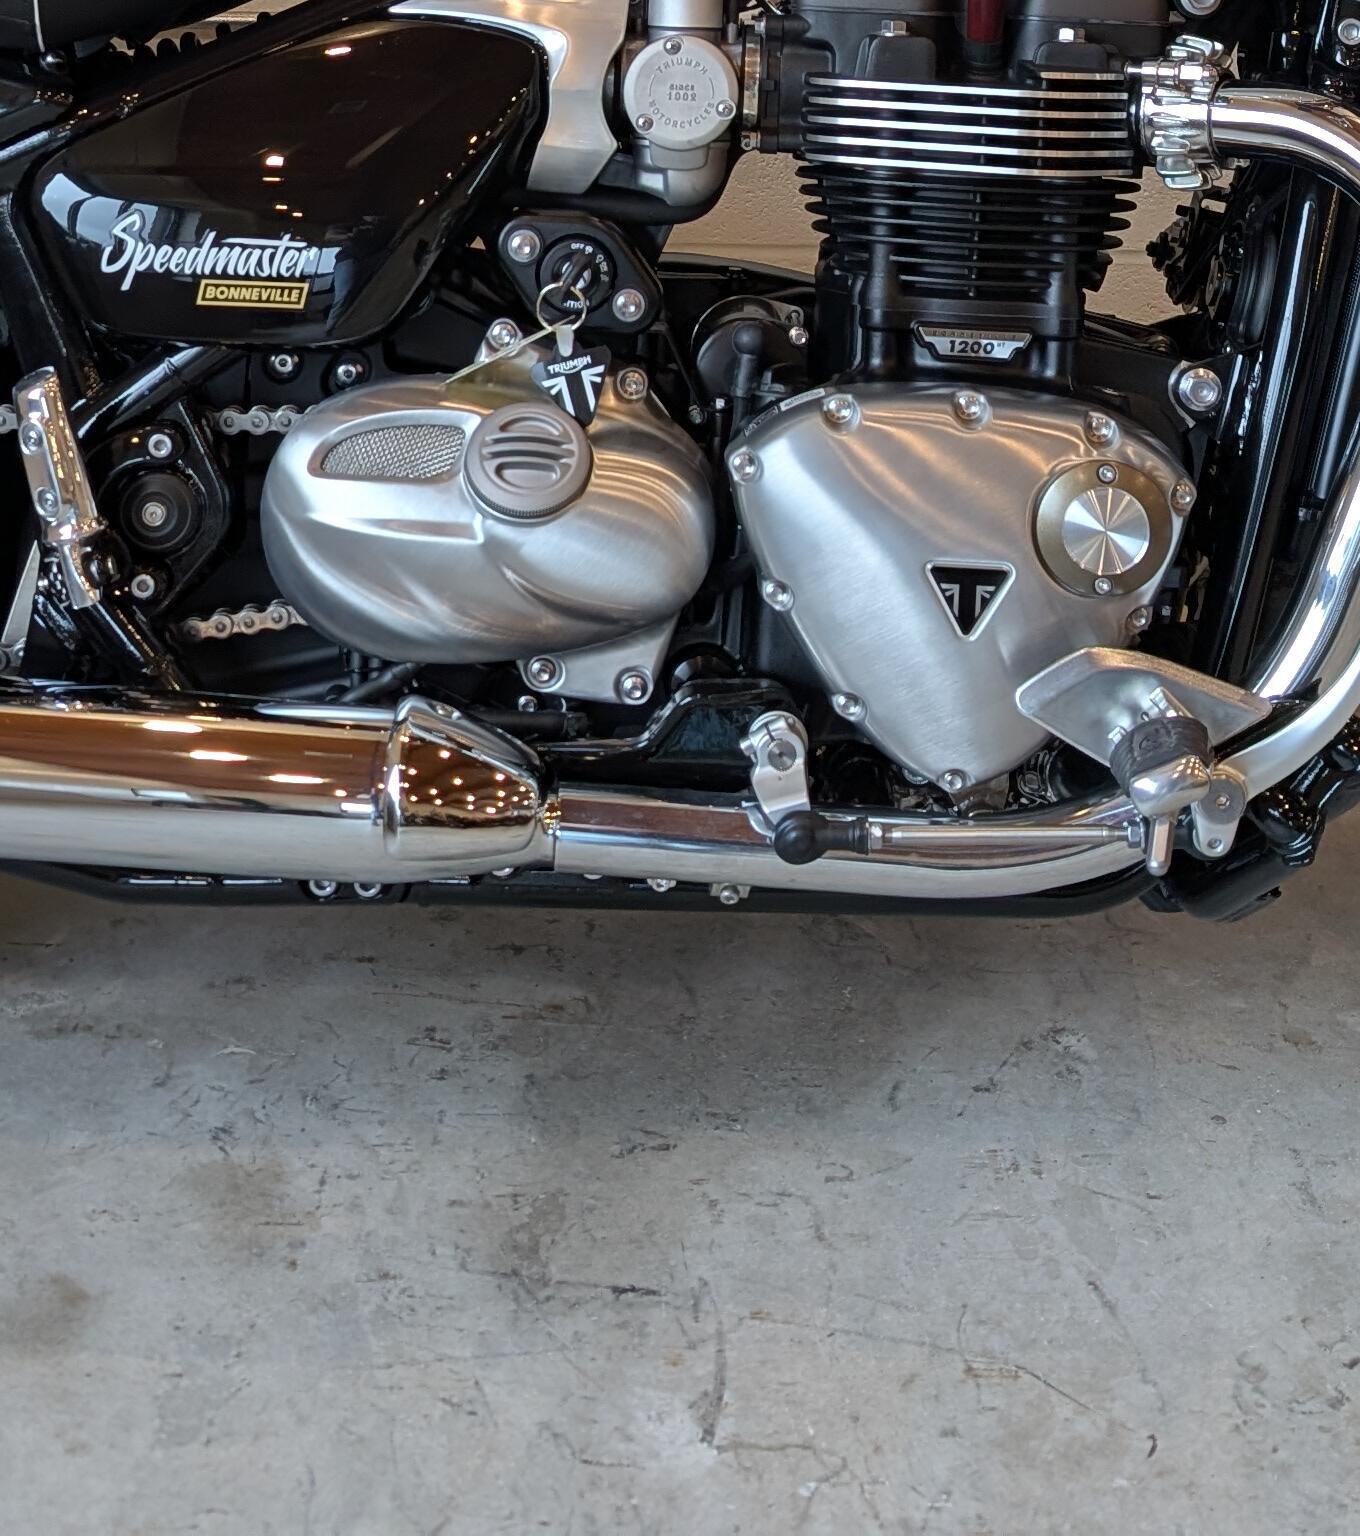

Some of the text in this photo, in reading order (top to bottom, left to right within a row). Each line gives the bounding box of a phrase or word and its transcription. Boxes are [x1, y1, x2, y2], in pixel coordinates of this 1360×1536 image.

[655, 56, 708, 75] TRIUMPH
[648, 98, 714, 128] MOTORCYCLES
[100, 213, 320, 291] Speedmaster
[203, 285, 301, 303] BONNEVILLE
[949, 339, 995, 354] 1200
[546, 354, 592, 374] TRIUMPH
